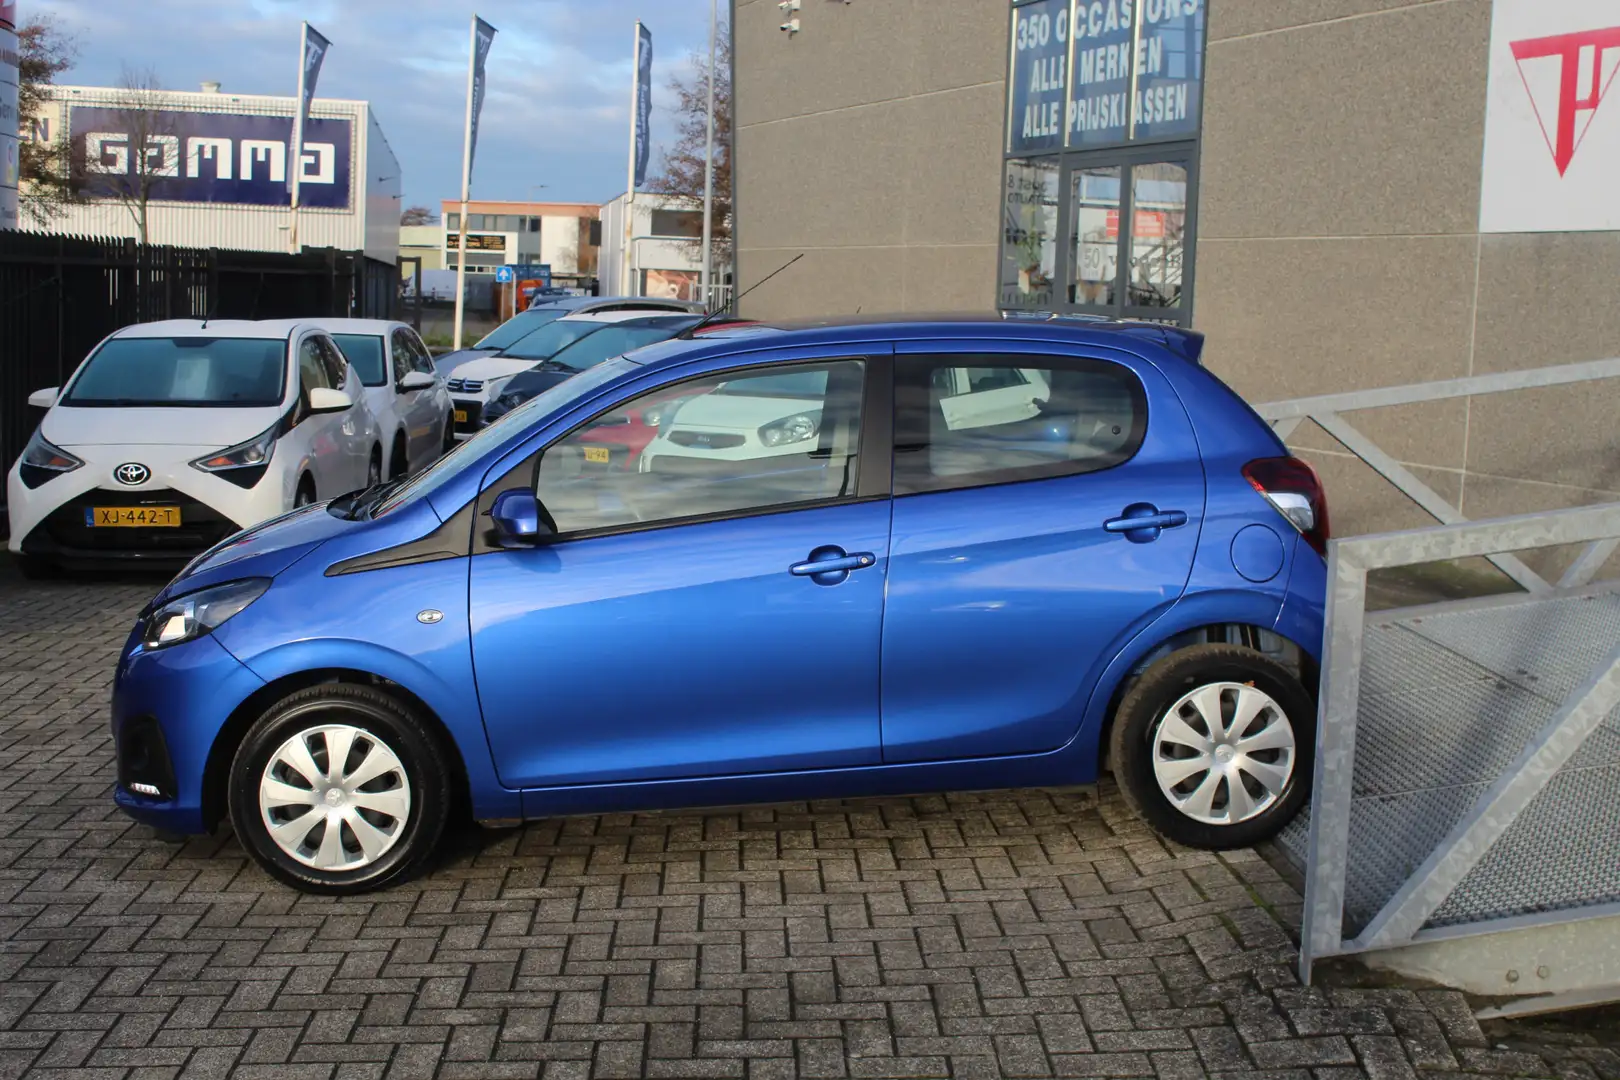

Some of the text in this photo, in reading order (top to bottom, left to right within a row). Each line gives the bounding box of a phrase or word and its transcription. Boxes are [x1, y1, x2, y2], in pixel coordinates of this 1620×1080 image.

[1017, 13, 1050, 51] 350
[1080, 36, 1162, 85] MERKEN
[1022, 101, 1059, 138] ALLE
[101, 509, 174, 524] XJ-442-T
